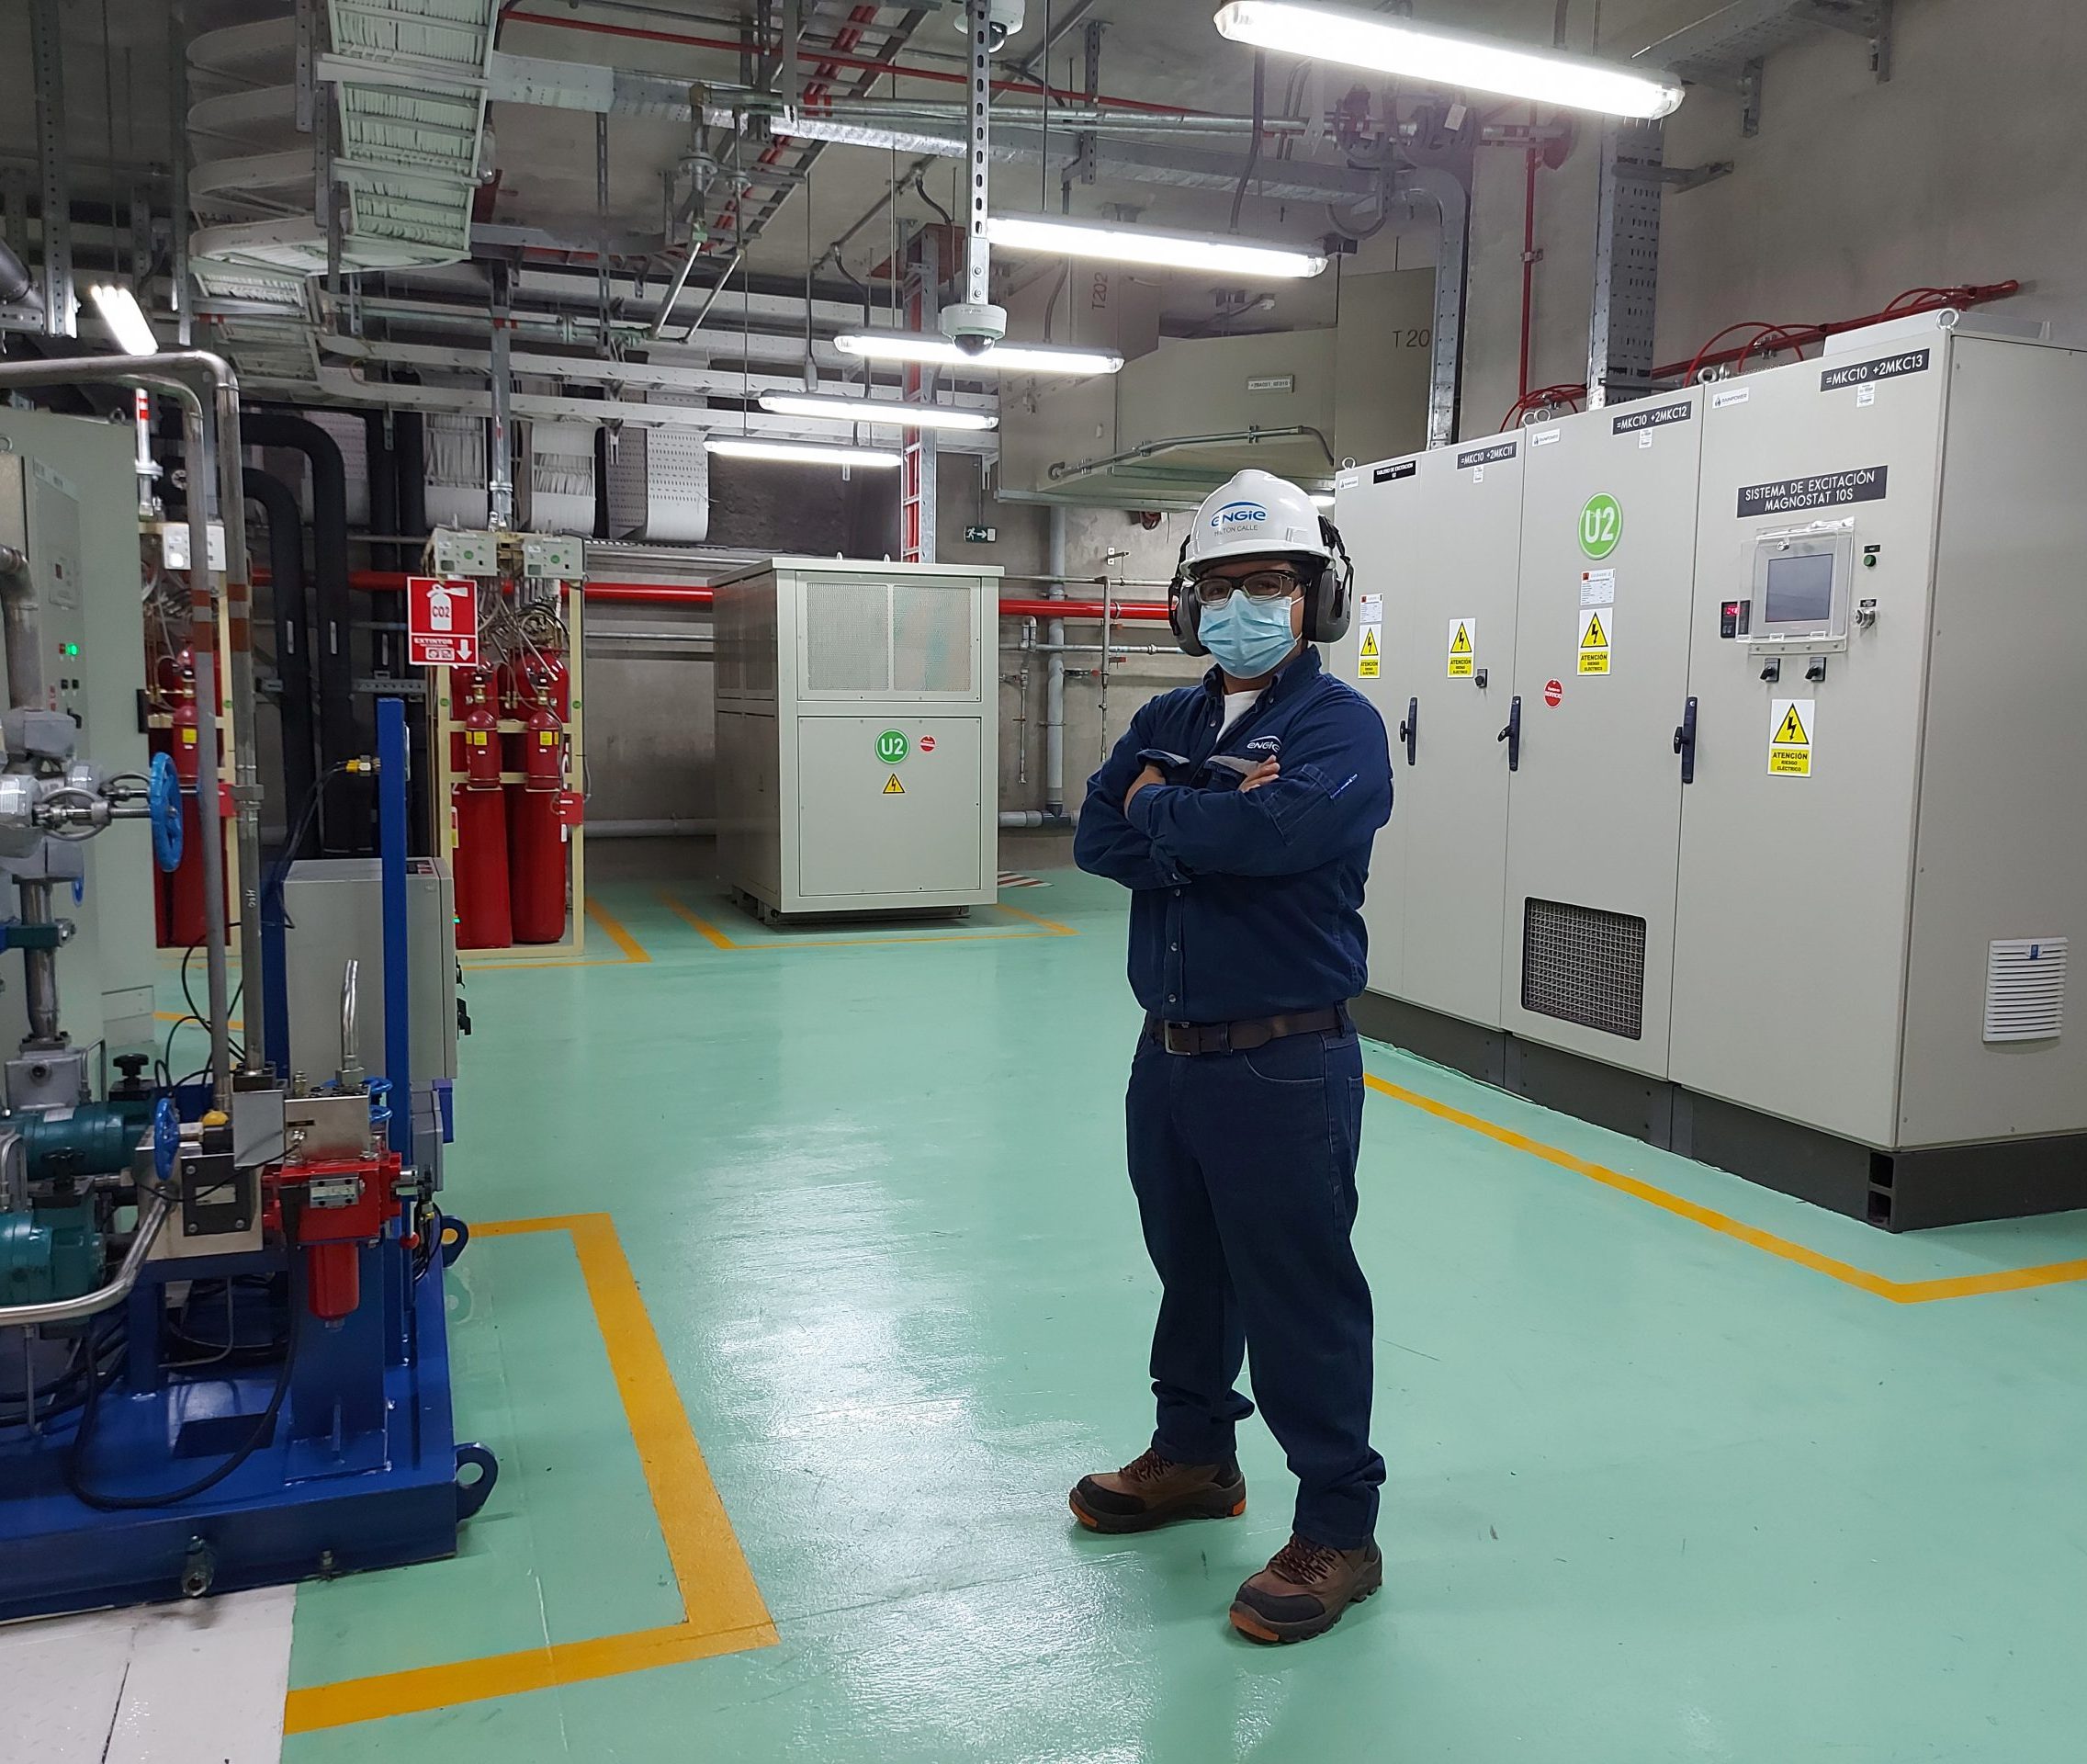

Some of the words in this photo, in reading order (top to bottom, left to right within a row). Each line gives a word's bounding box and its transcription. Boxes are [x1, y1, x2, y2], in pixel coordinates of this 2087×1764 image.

[1091, 272, 1108, 311] T202
[1825, 367, 1867, 386] =MKC10
[1873, 355, 1923, 376] +2MKC13
[1617, 414, 1647, 430] =MKC10
[1651, 406, 1687, 423] +2MKC12
[1461, 451, 1484, 465] =MKC10
[1486, 446, 1513, 459] +2MKC11
[1745, 484, 1786, 502] SISTEMA
[1790, 481, 1803, 494] DE
[1808, 469, 1875, 492] EXCITACIÓN
[1764, 492, 1830, 512] MAGNOSTAT
[1836, 488, 1854, 503] 10S
[1214, 526, 1235, 537] MLTON
[1585, 506, 1616, 544] U2
[432, 605, 450, 618] CO2
[1580, 652, 1608, 662] ATENCIÓN
[881, 738, 904, 755] U2
[1772, 751, 1808, 760] ATENCIÓN
